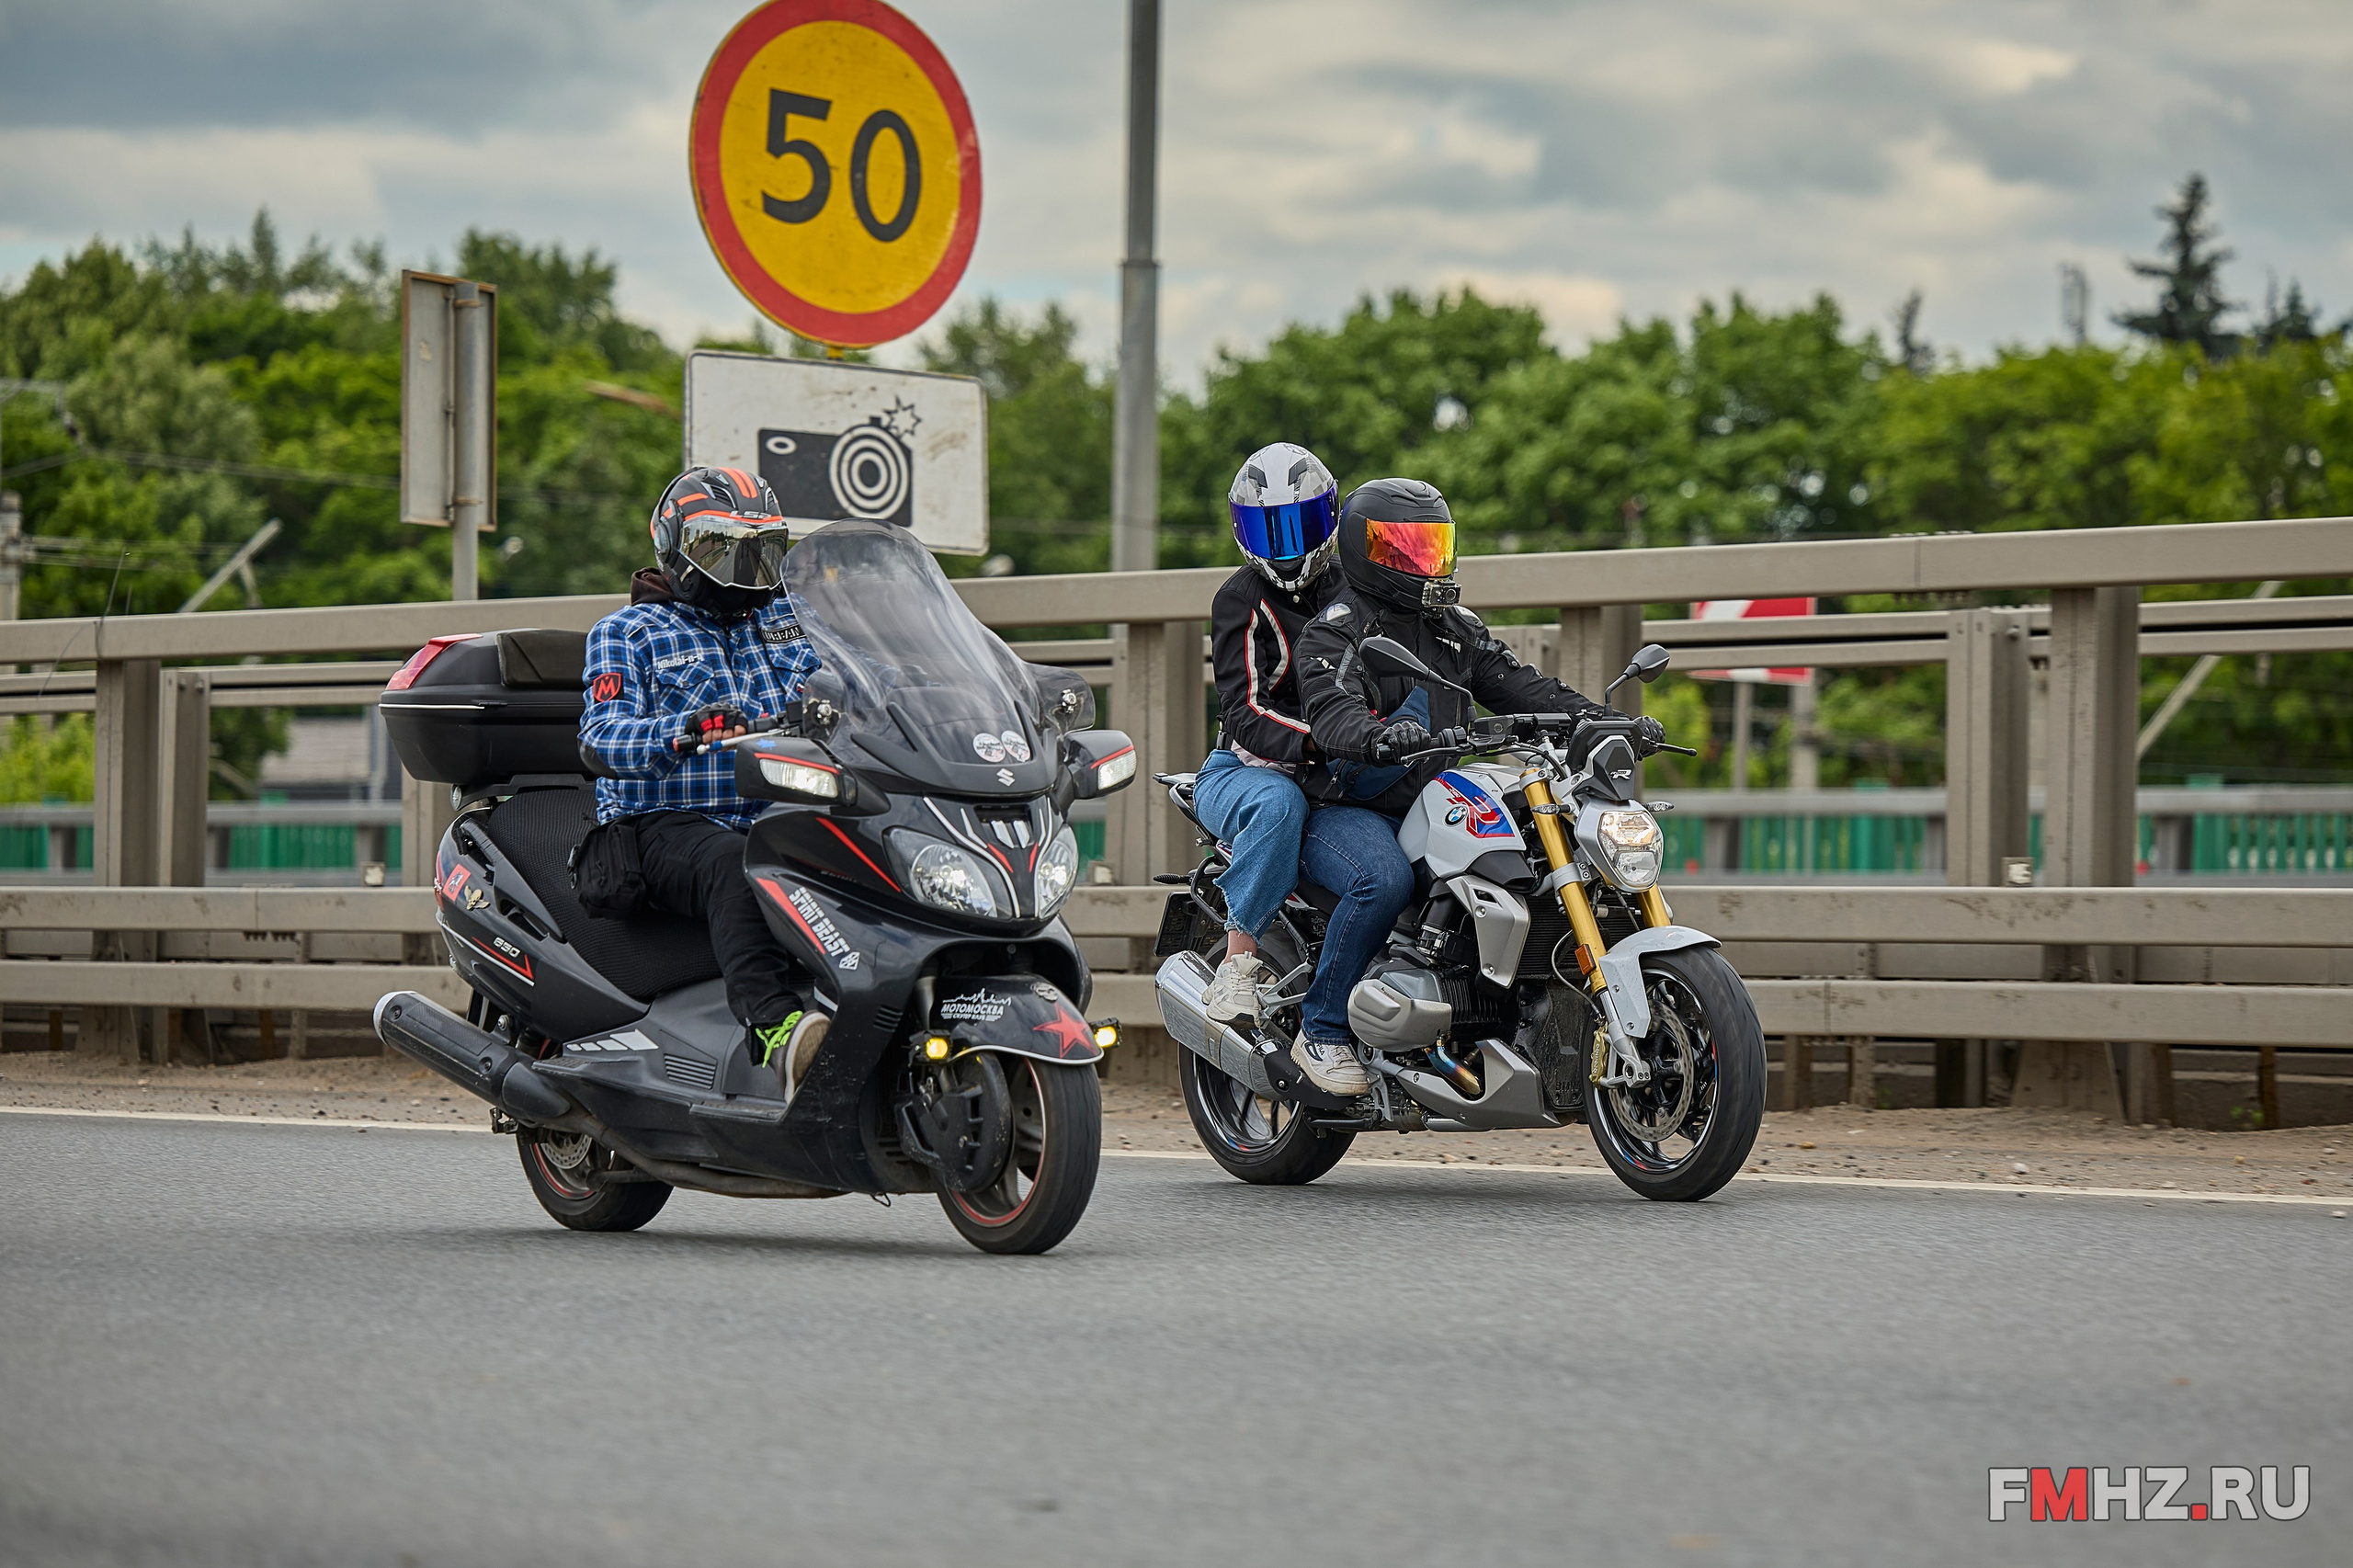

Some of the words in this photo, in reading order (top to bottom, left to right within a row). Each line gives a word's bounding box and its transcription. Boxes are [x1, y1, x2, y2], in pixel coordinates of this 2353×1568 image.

[761, 87, 923, 243] 50
[729, 510, 772, 520] LS2
[764, 627, 801, 641] URBAN
[789, 886, 825, 925] SPIRIT
[812, 917, 851, 957] BEAST
[493, 937, 521, 958] 650
[940, 1004, 1005, 1016] МОТОМОСКВА
